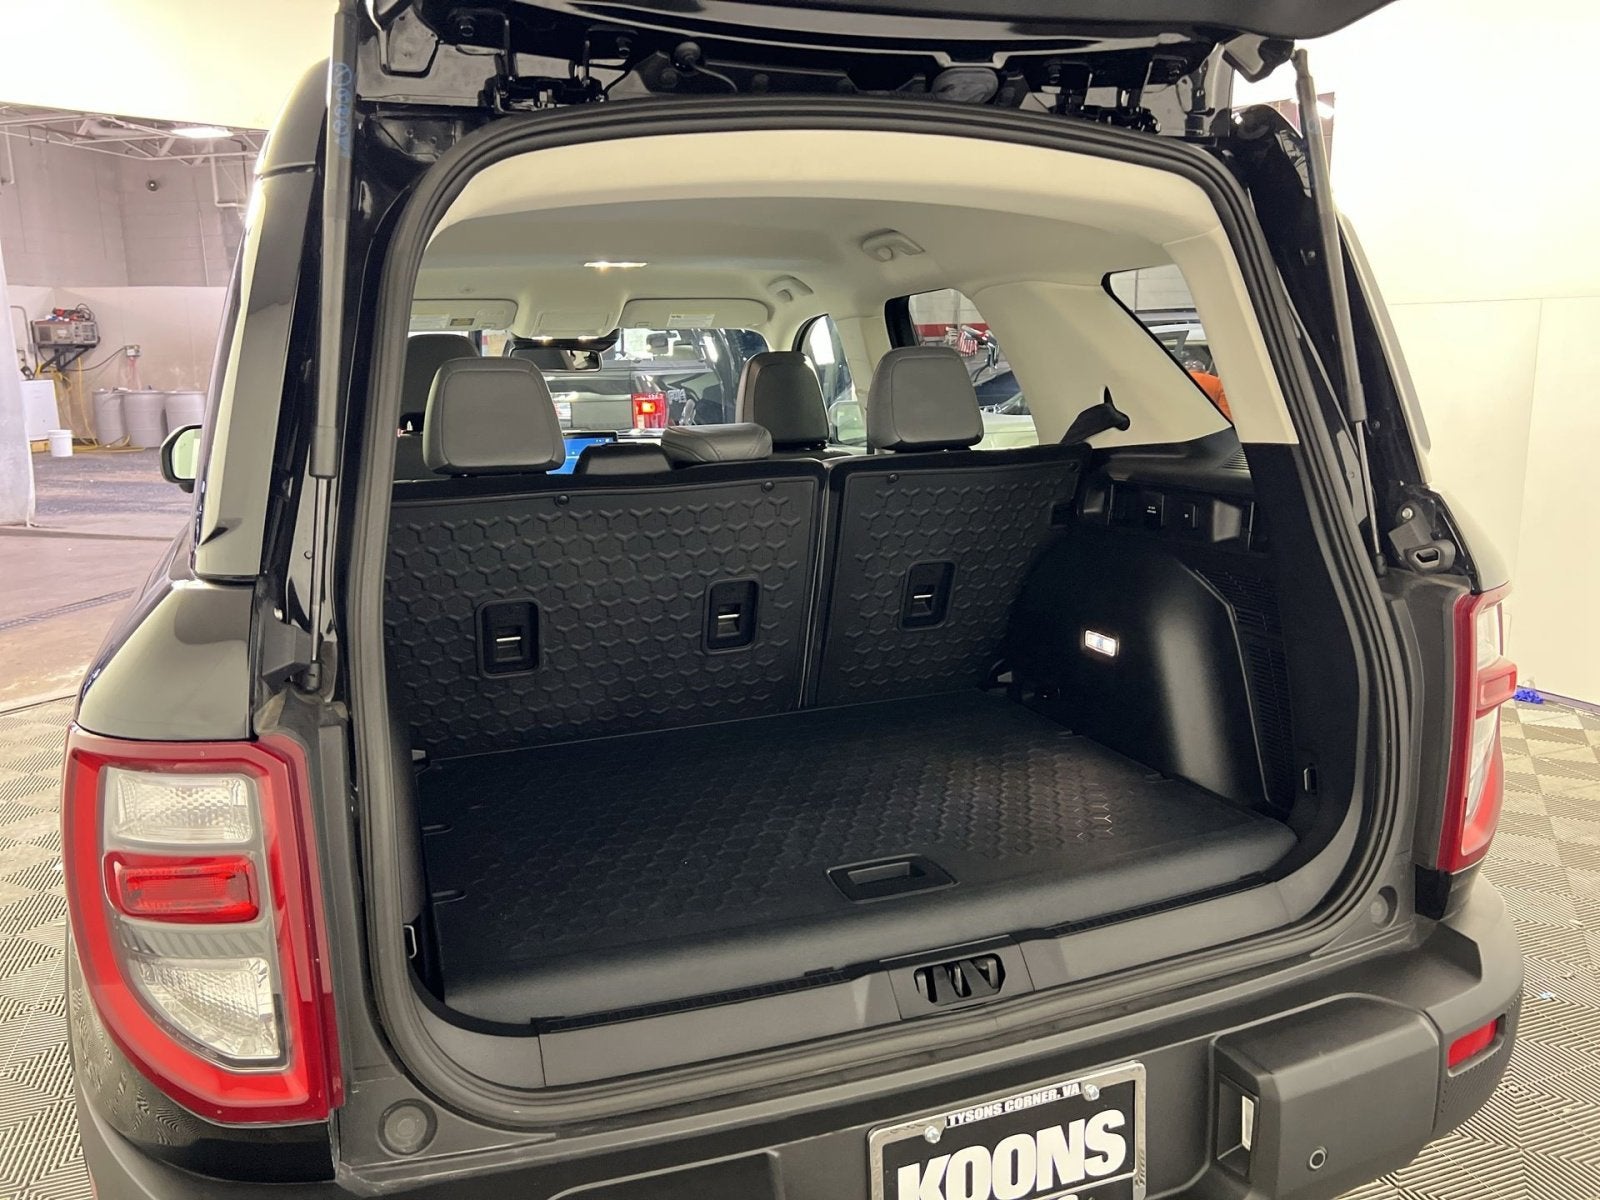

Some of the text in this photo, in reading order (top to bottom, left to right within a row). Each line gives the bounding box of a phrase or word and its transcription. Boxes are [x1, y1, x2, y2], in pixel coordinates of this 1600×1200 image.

[948, 1103, 1003, 1126] TYSONS
[1062, 1082, 1081, 1098] VA
[898, 1109, 1126, 1200] KOONS
